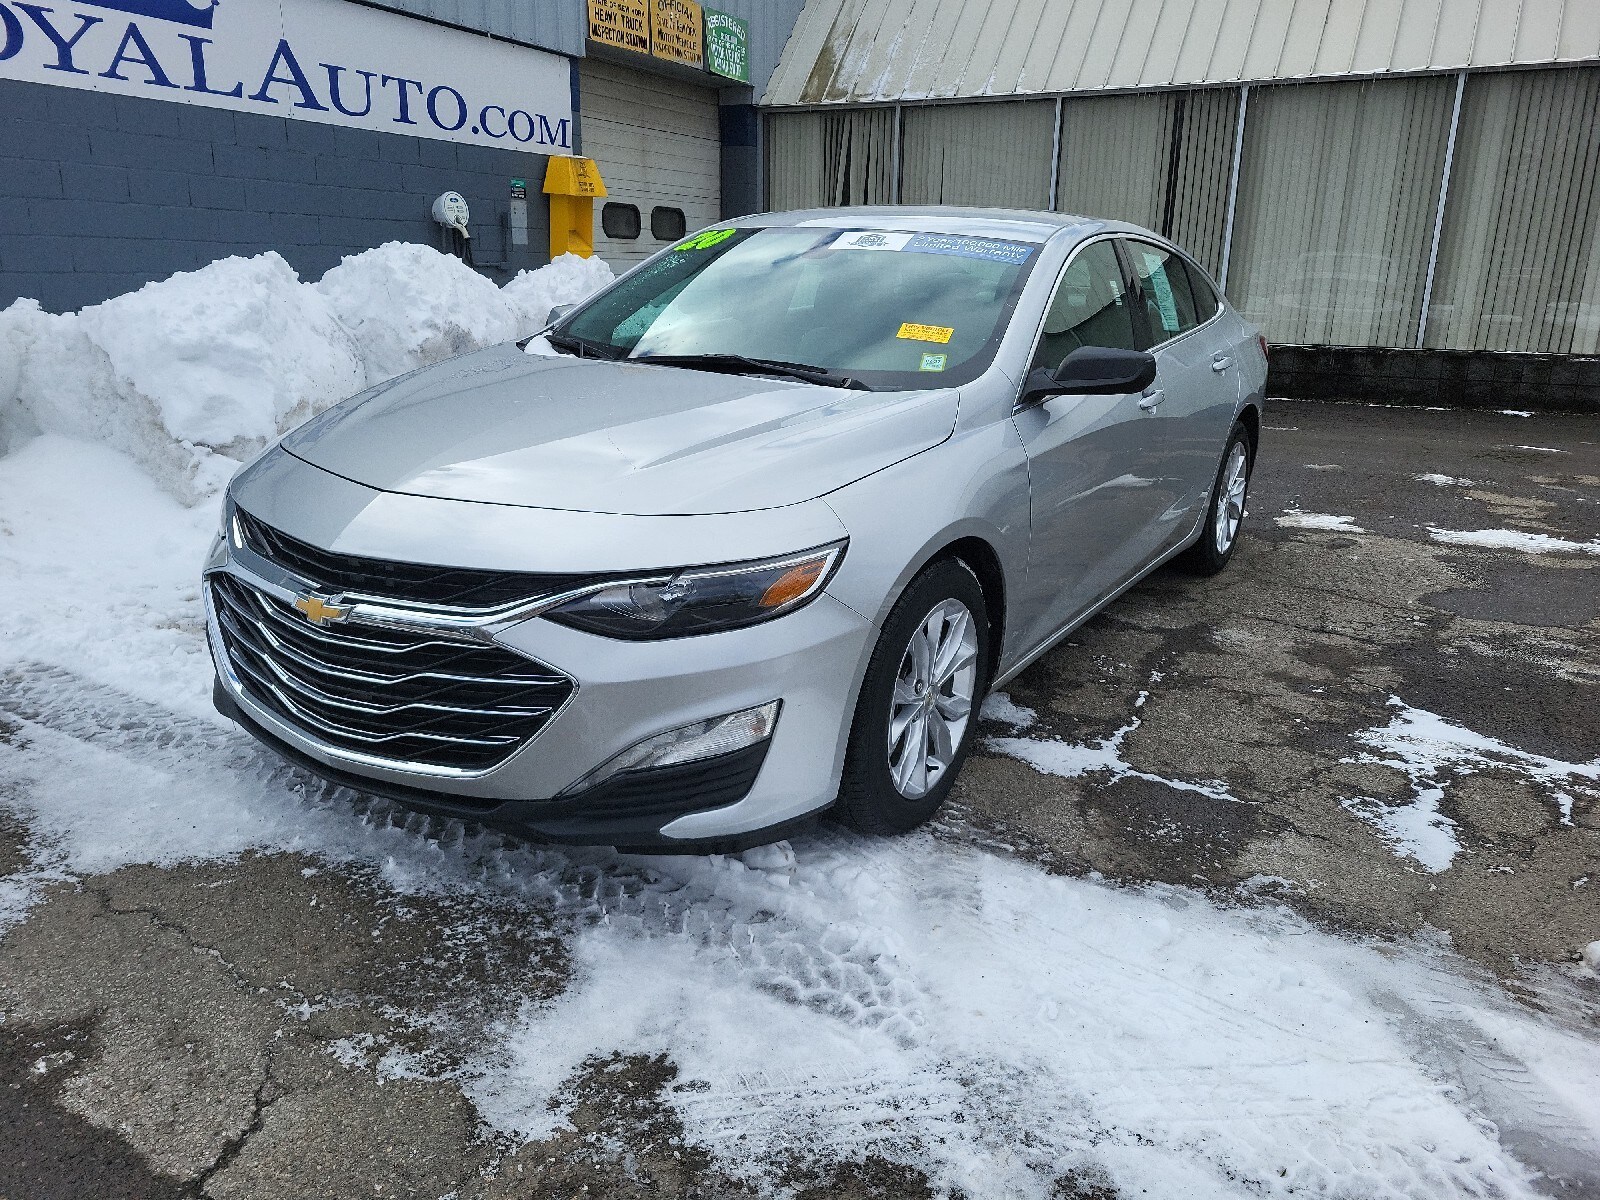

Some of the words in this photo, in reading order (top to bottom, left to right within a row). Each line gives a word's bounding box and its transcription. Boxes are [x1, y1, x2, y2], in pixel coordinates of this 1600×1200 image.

[594, 7, 617, 25] HEAVY
[621, 14, 643, 33] TRUCK
[657, 0, 694, 25] OFFICIAL
[591, 23, 625, 44] INSPECTION
[625, 32, 648, 49] STATION
[708, 14, 746, 41] REGISTERED
[914, 241, 960, 250] Limited
[964, 245, 1024, 258] Warranty
[1002, 244, 1027, 252] Mile
